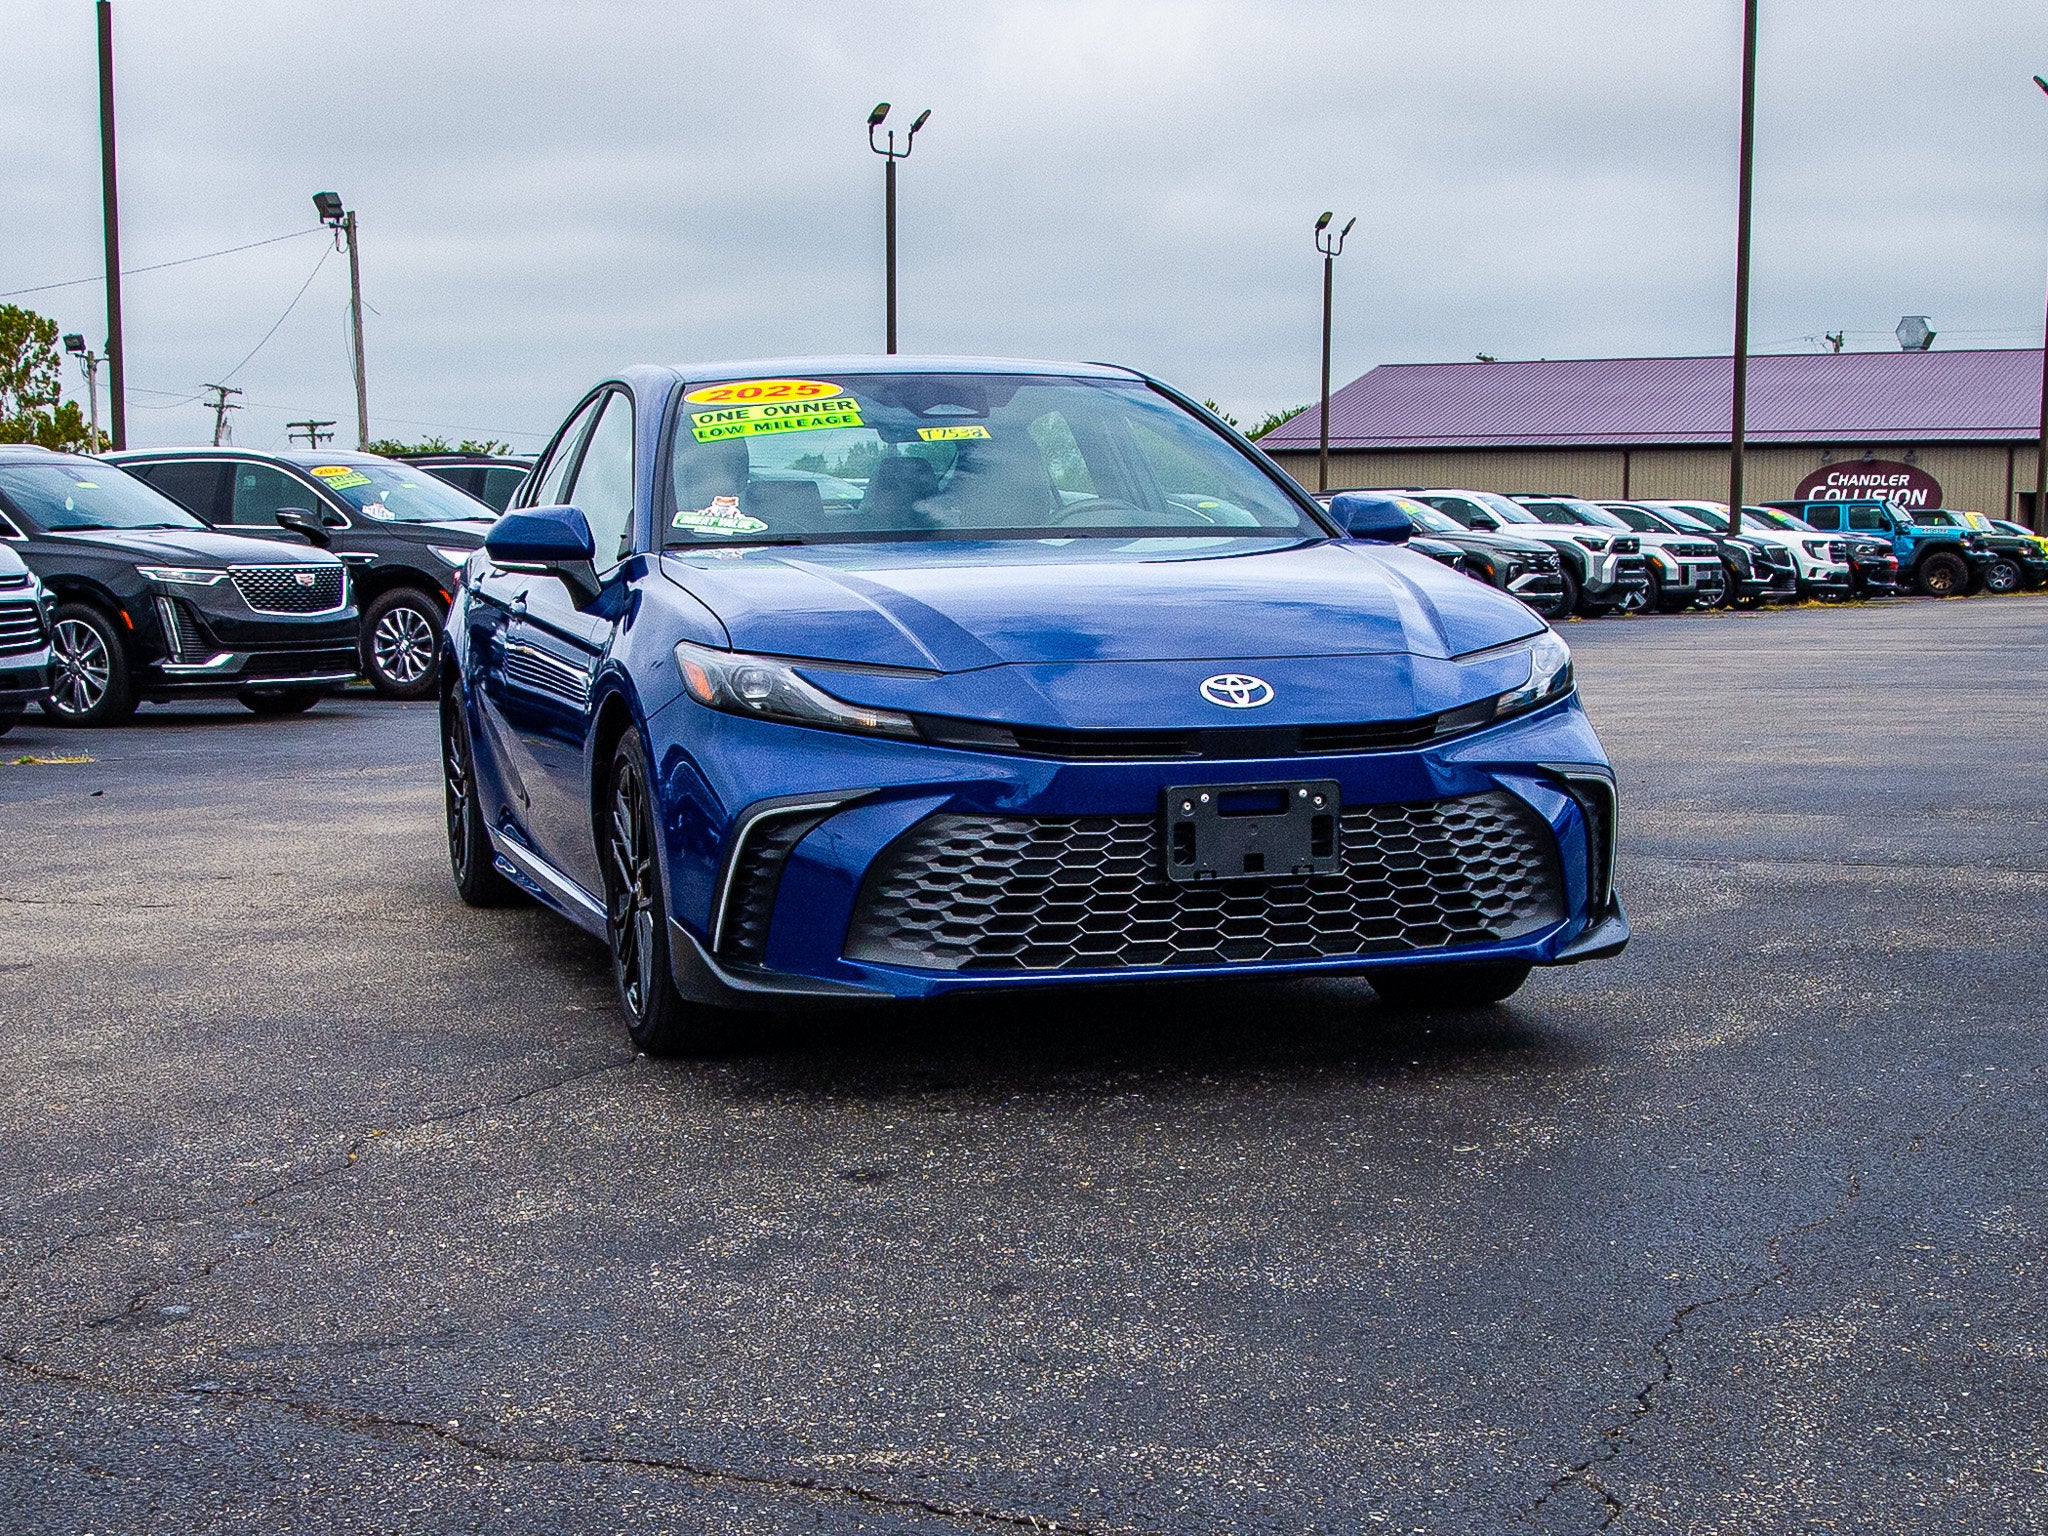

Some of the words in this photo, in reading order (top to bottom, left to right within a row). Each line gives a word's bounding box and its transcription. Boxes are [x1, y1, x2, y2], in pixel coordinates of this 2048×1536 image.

[705, 384, 823, 402] 2025
[699, 408, 750, 424] ONE
[763, 400, 854, 416] OWNER
[698, 424, 744, 439] LOW
[754, 414, 853, 432] MILEAGE
[1827, 472, 1910, 486] CHANDLER
